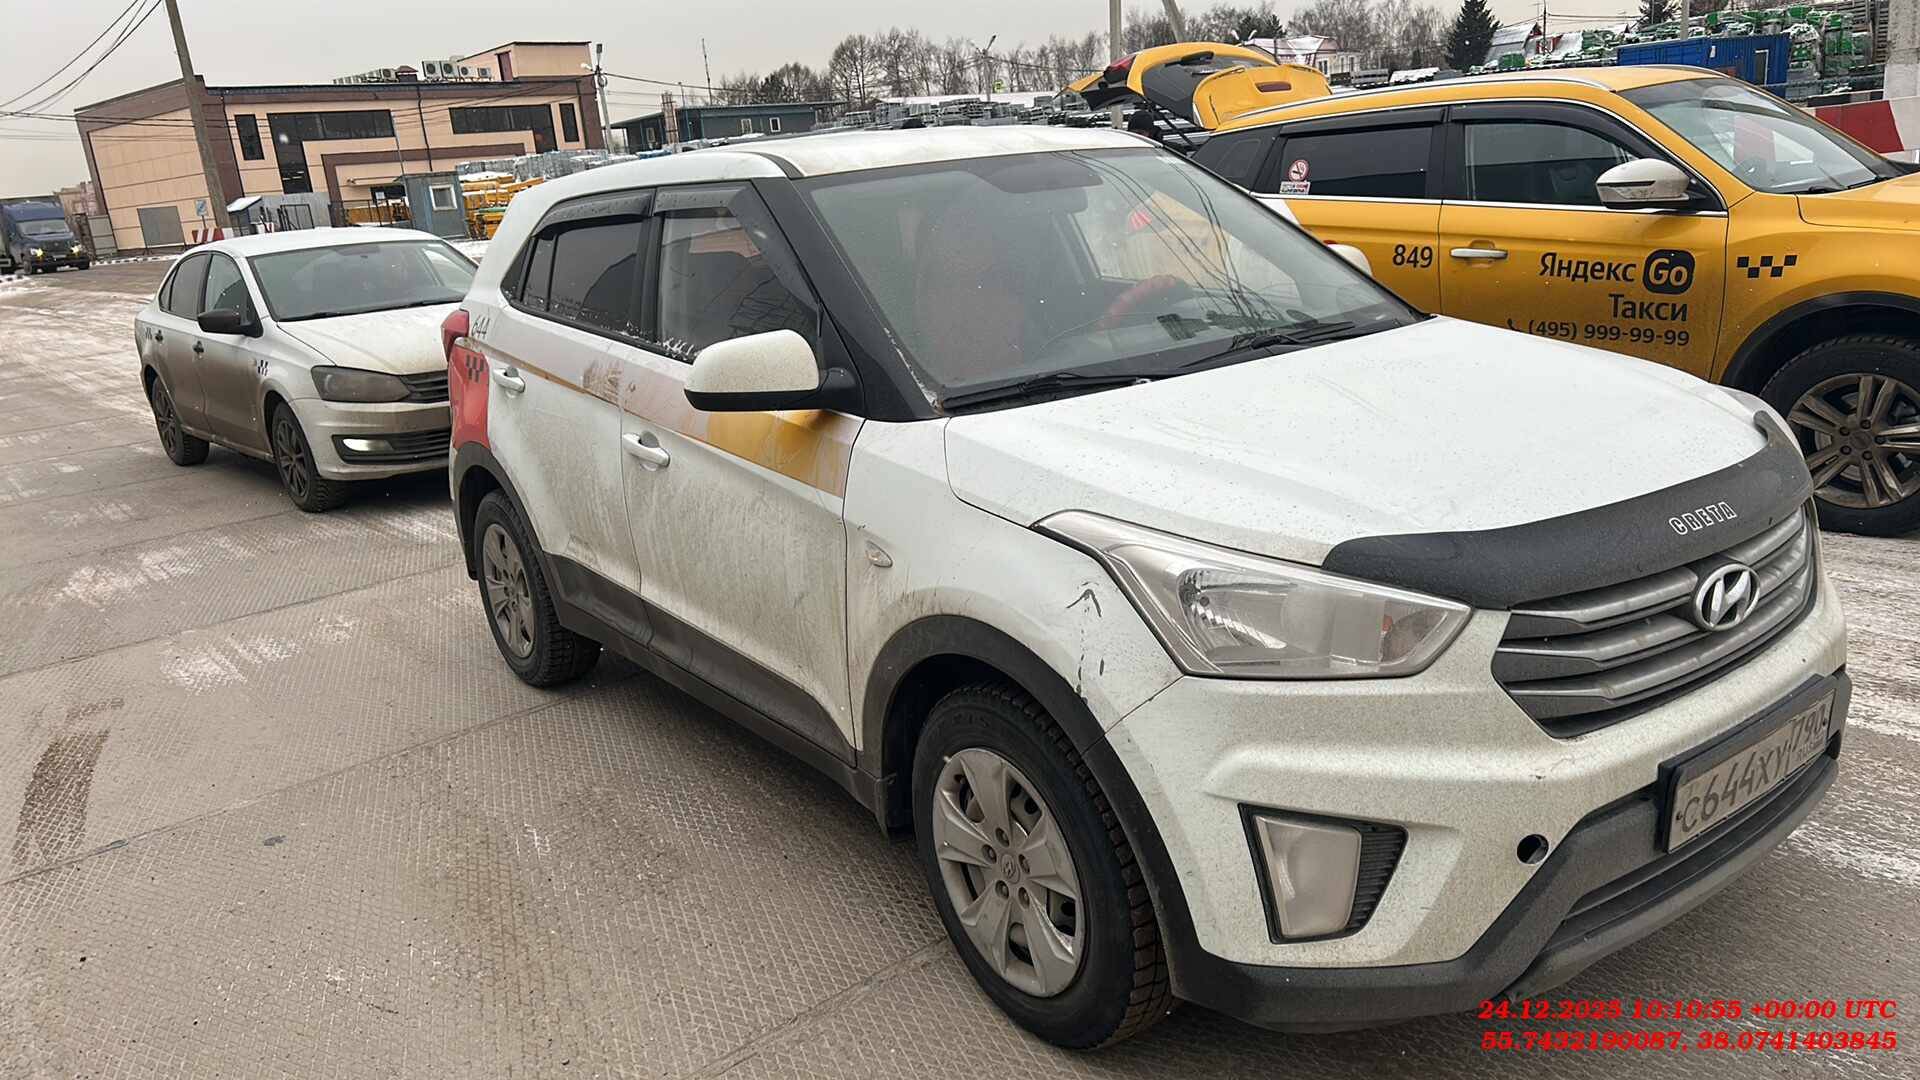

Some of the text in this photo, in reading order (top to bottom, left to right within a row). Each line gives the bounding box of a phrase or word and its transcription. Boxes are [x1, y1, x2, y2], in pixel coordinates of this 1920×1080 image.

[1392, 244, 1433, 268] 849
[1539, 253, 1688, 287] Яндекс Go
[1608, 293, 1688, 322] Такси
[471, 315, 490, 340] 644
[1528, 319, 1690, 346] (495) 999-99-99
[1668, 501, 1738, 535] CRETA
